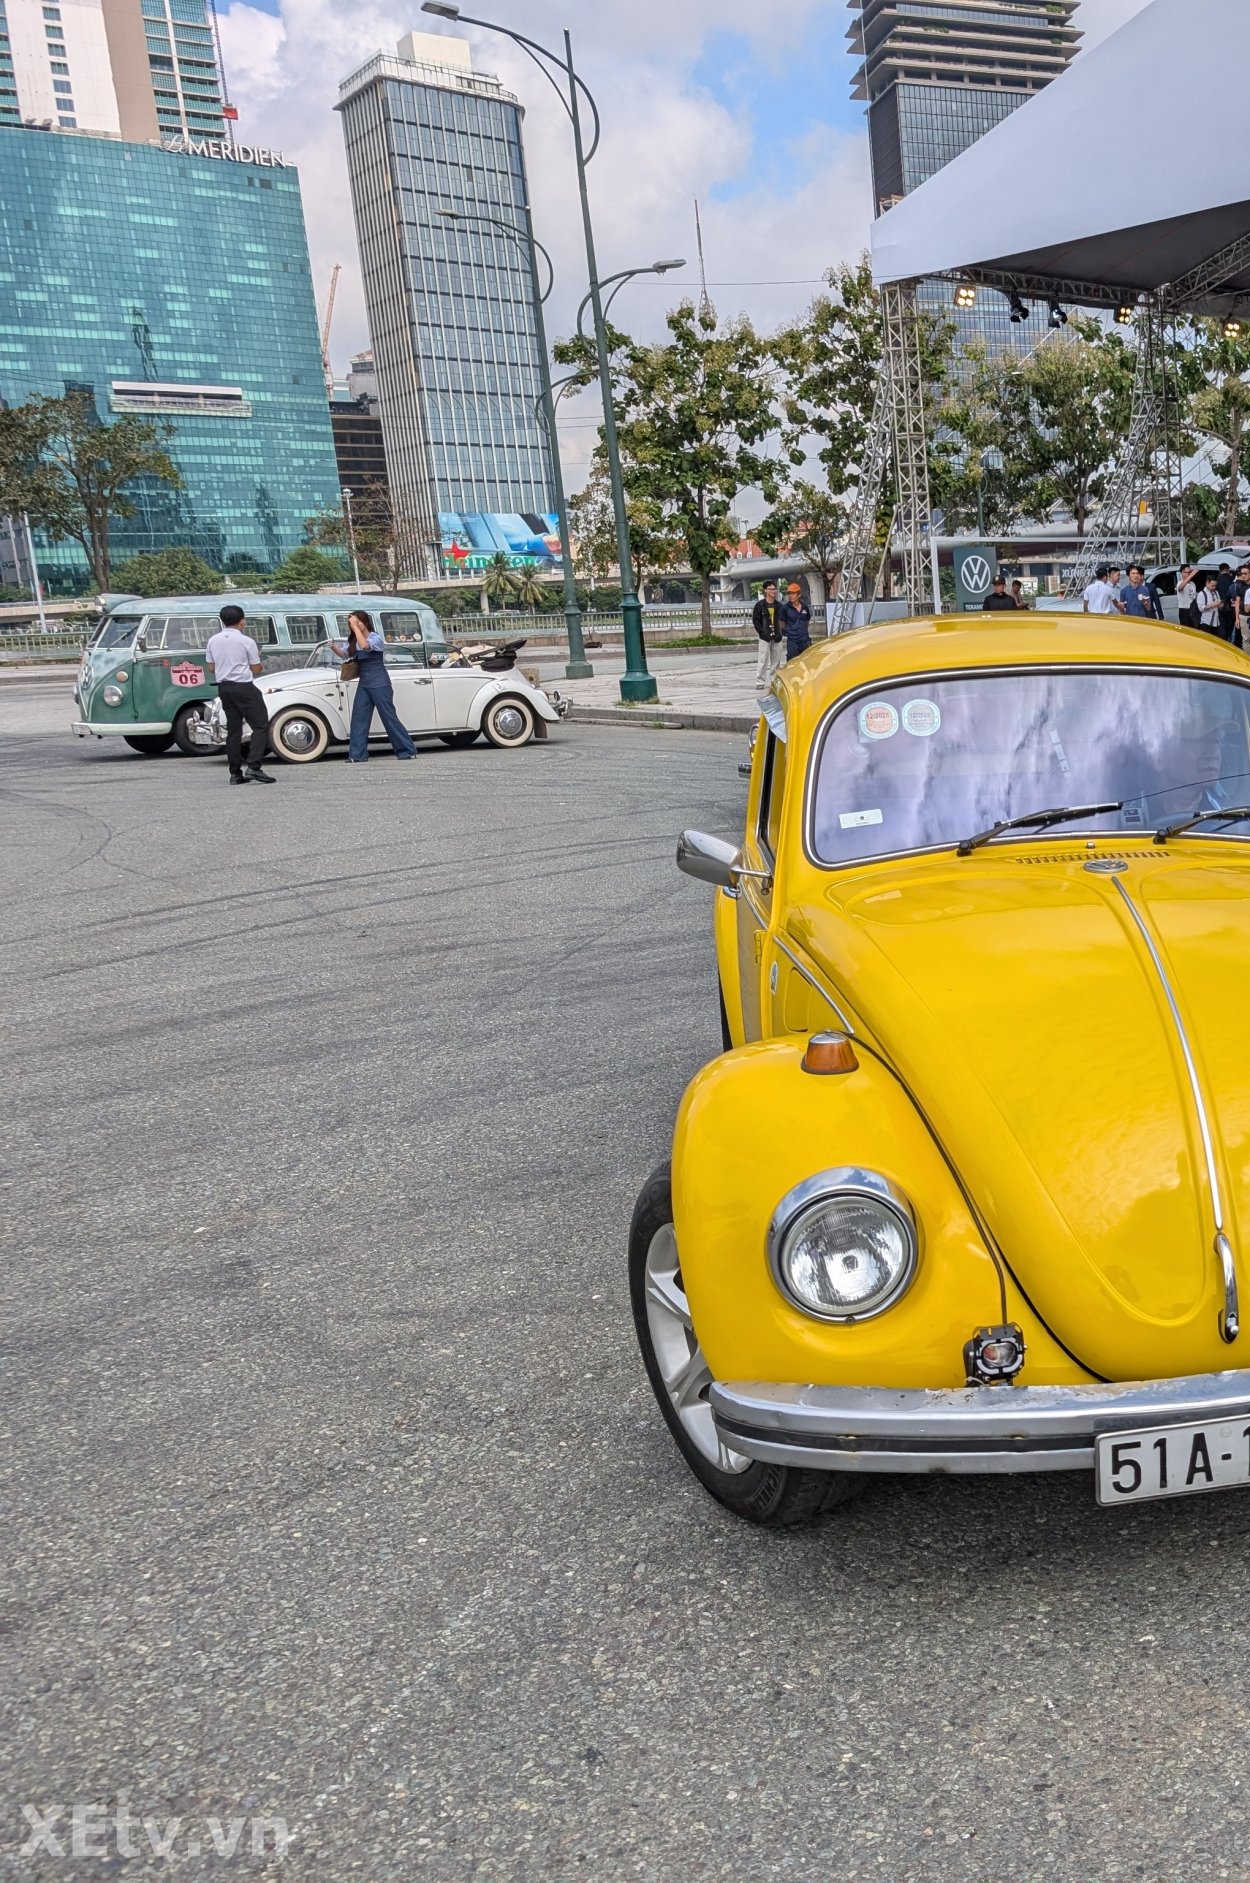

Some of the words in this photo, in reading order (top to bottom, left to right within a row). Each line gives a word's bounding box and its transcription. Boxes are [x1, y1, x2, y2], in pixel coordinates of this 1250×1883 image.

[188, 137, 287, 168] MERIDIEN
[965, 603, 984, 611] TERAM
[179, 674, 198, 685] 06
